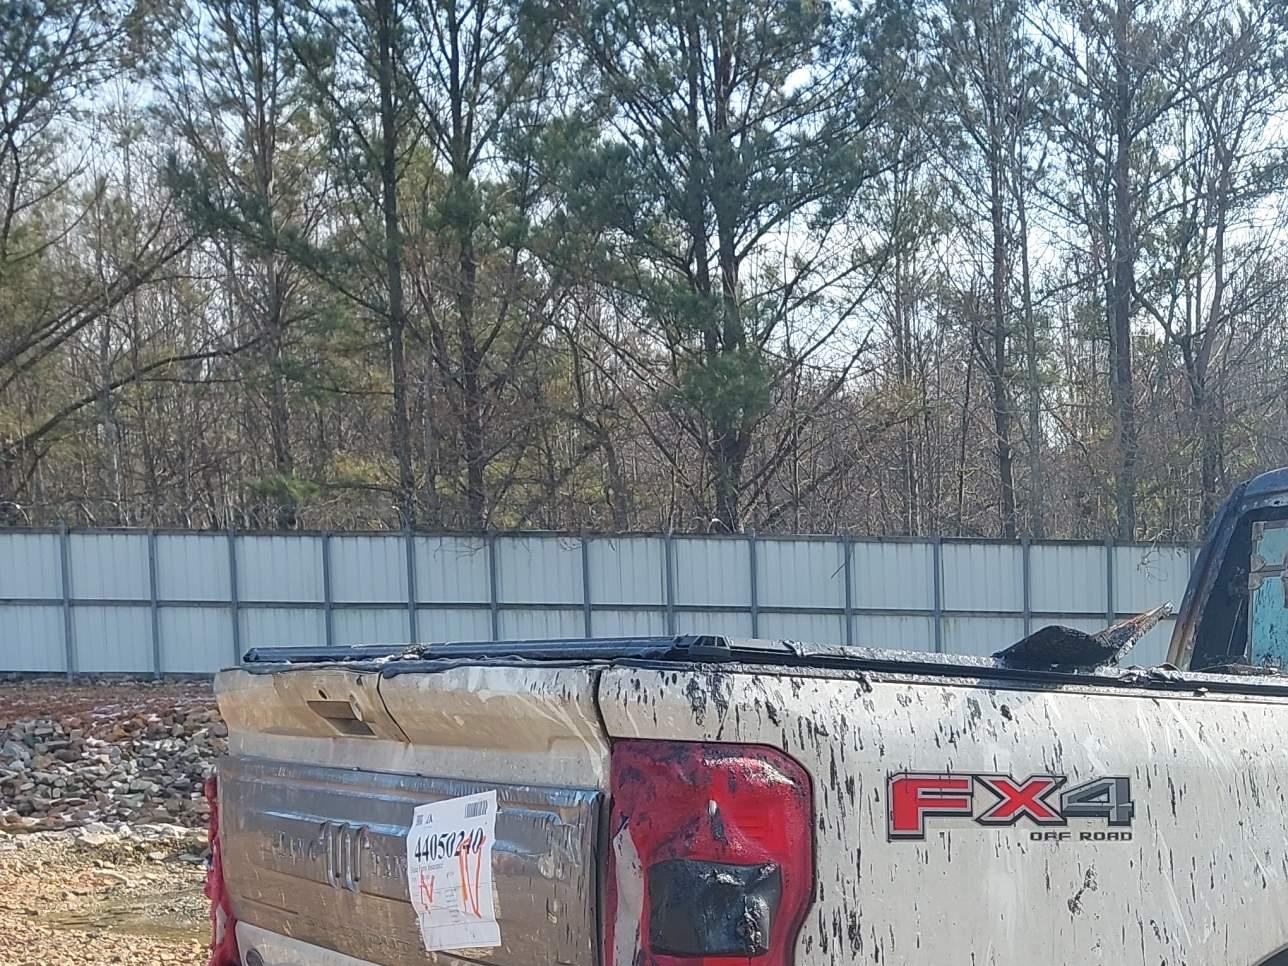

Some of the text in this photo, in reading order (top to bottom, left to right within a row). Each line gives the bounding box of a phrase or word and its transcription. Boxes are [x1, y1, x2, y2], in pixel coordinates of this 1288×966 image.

[886, 773, 1134, 842] FX4
[414, 827, 484, 862] 44050240
[1030, 831, 1132, 842] OFF ROAD
